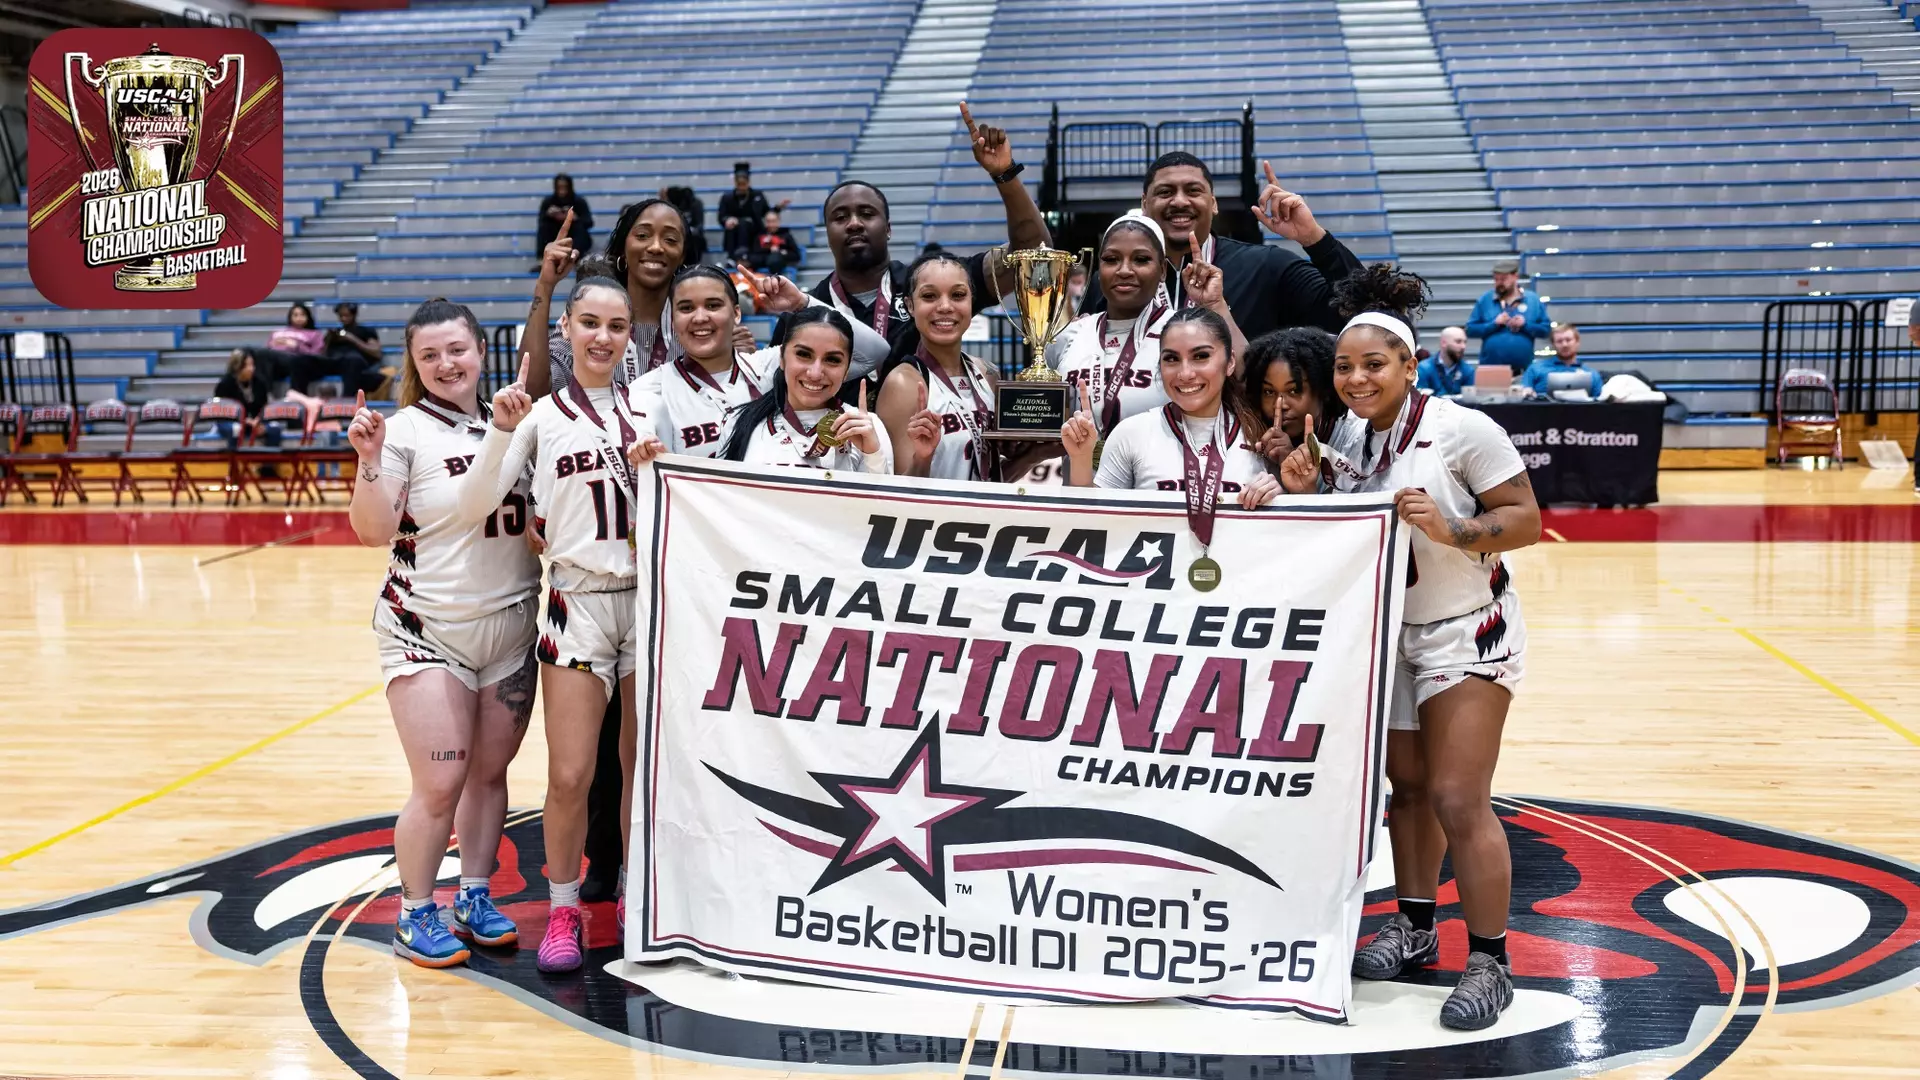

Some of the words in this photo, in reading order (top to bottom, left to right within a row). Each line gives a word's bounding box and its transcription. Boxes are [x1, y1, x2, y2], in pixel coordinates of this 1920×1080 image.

[1105, 360, 1129, 401] USCAA
[1545, 428, 1561, 445] &
[1563, 428, 1639, 446] Stratton
[603, 446, 631, 488] USCAA
[1202, 470, 1219, 515] USCAA
[861, 514, 1176, 591] USCAA
[729, 570, 972, 629] SMALL
[1001, 592, 1327, 652] COLLEGE
[702, 617, 1325, 763] NATIONAL
[1057, 755, 1315, 798] CHAMPIONS
[954, 883, 973, 895] TM
[1007, 870, 1229, 933] Women's
[775, 895, 1018, 966] Basketball
[1032, 928, 1077, 972] DI
[1103, 935, 1317, 984] 2025-'26
